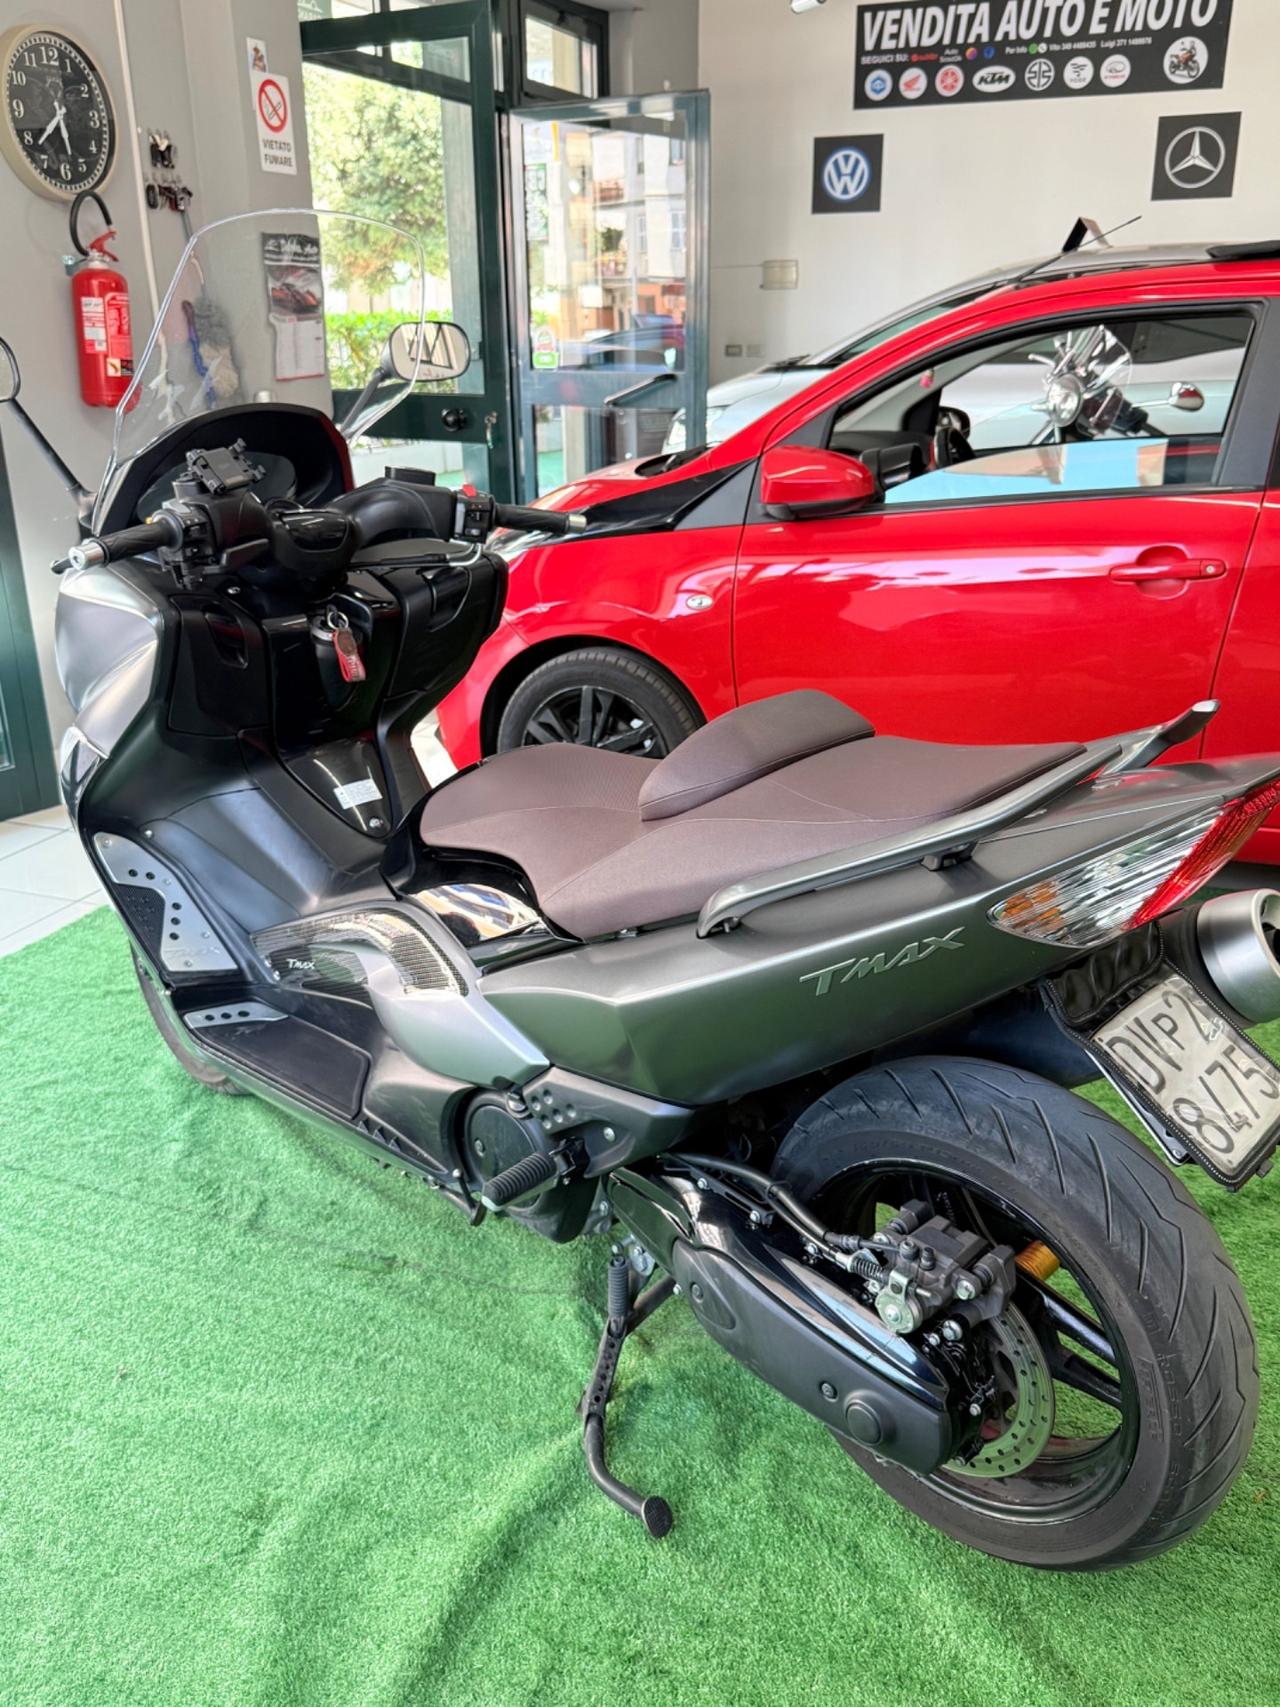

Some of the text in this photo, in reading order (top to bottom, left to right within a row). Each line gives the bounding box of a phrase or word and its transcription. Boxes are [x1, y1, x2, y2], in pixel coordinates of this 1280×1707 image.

[863, 0, 1218, 51] VENDITA AUTO E MOTO
[24, 52, 37, 67] 11
[40, 46, 59, 66] 12
[861, 54, 893, 64] SEGUICI
[65, 59, 72, 73] 1
[12, 70, 26, 86] 10
[977, 72, 1011, 85] KTM
[80, 83, 89, 98] 2
[12, 99, 25, 118] 9
[89, 110, 100, 129] 3
[23, 130, 34, 145] 8
[89, 139, 97, 154] 4
[262, 139, 292, 152] VIETATO
[40, 154, 48, 169] 7
[78, 158, 87, 173] 5
[264, 153, 293, 167] FUMARE
[60, 162, 71, 181] 6
[799, 926, 965, 996] TMAX
[1172, 1045, 1280, 1153] 8475
